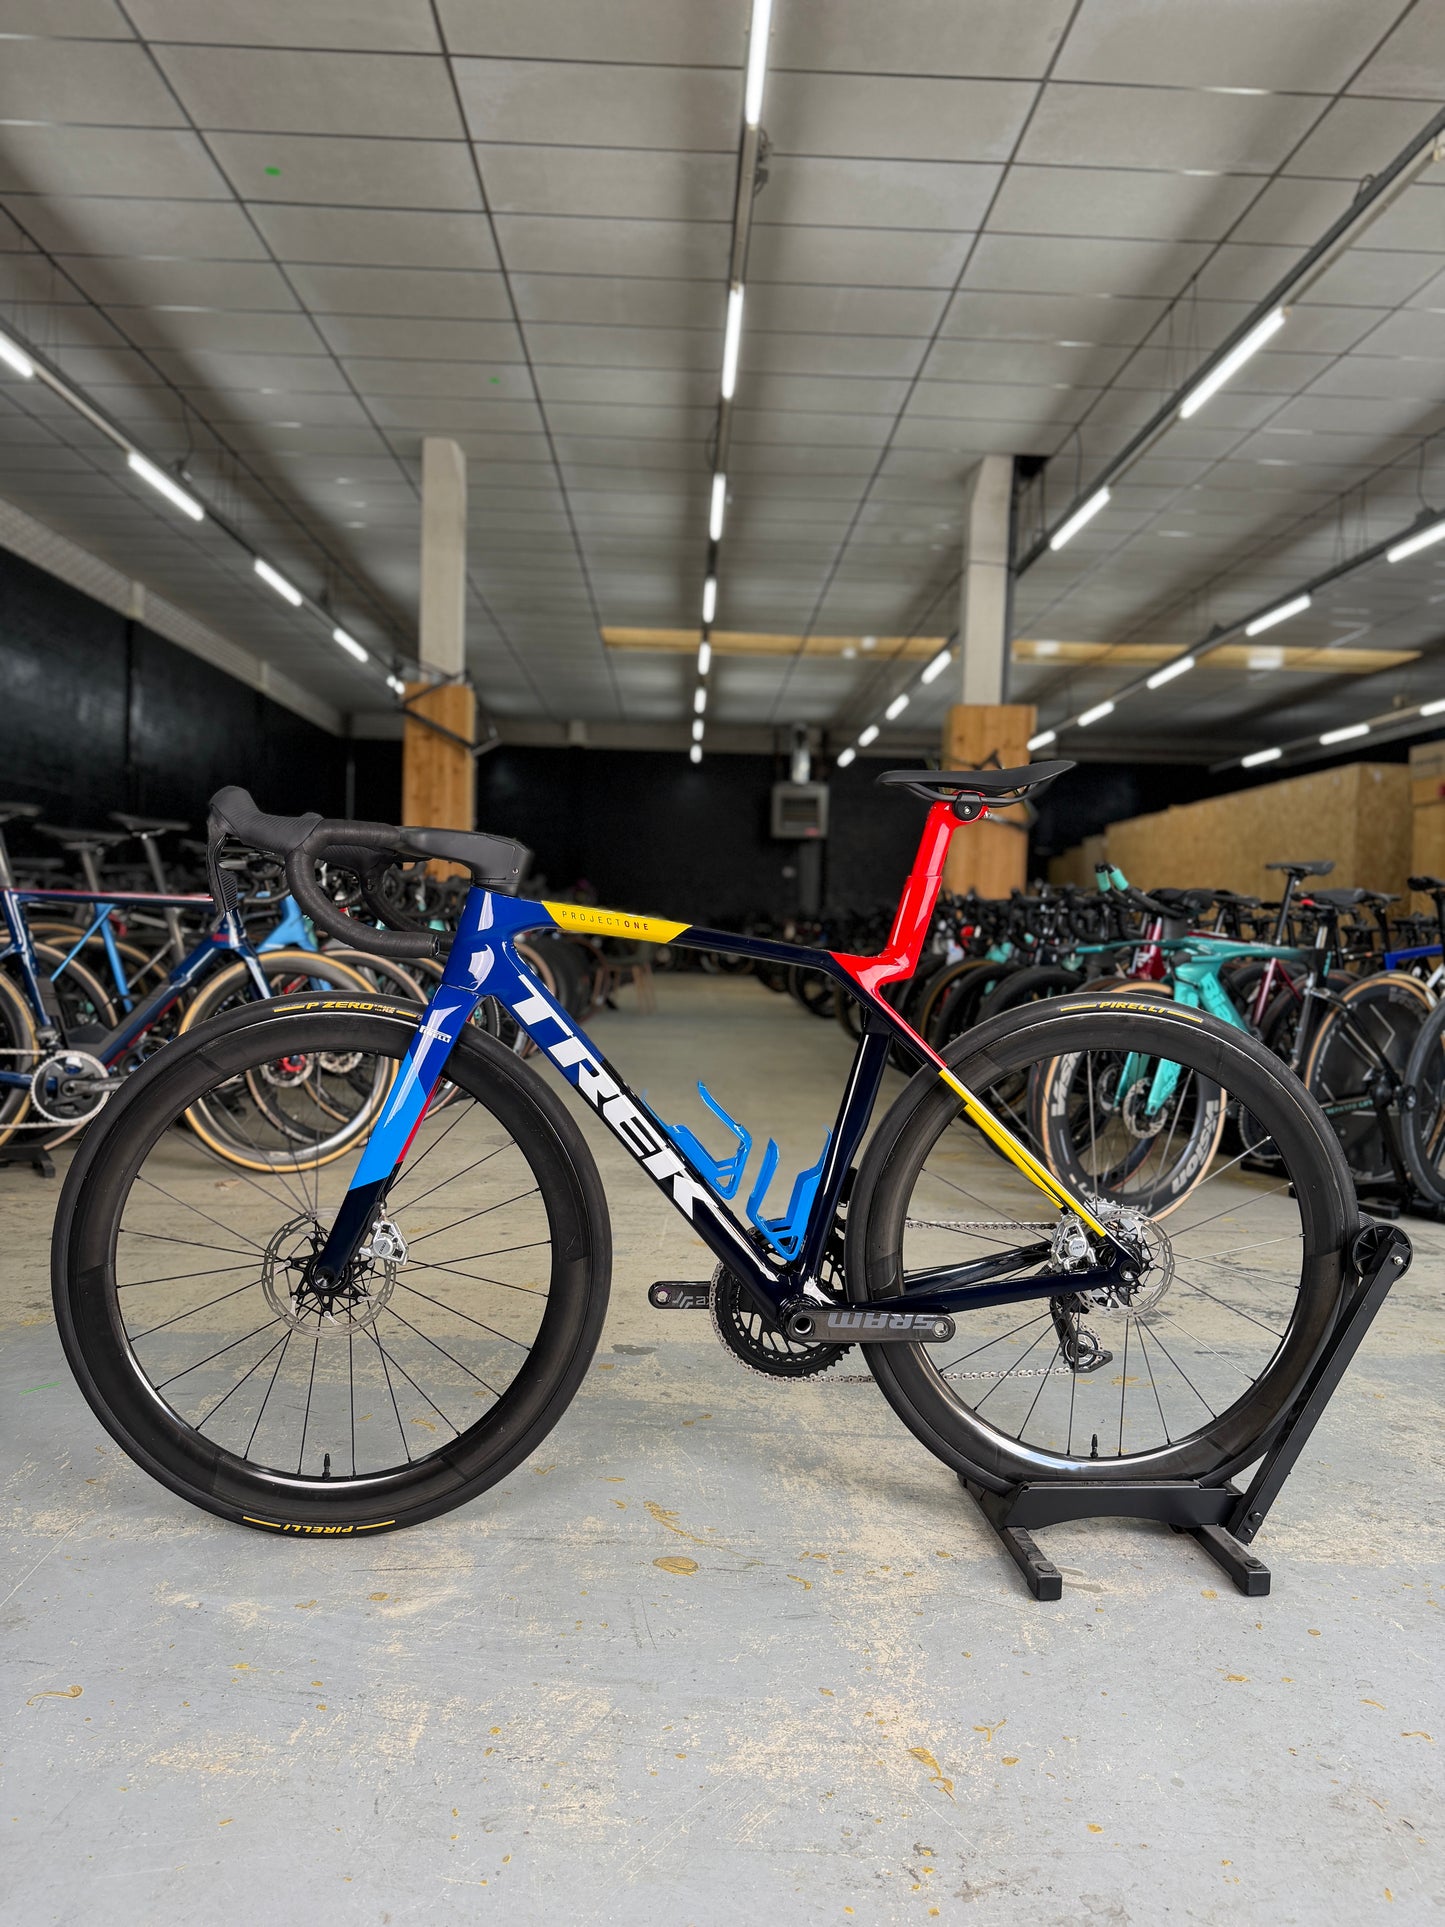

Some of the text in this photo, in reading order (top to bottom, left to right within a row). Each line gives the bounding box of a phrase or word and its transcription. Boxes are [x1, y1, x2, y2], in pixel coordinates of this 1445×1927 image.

[305, 1002, 319, 1010] P
[322, 1001, 374, 1010] ZERO
[1099, 1002, 1166, 1014] PIRELLI
[512, 974, 718, 1219] TREK
[827, 1312, 936, 1330] SRAM
[283, 1524, 354, 1534] PIRELLI
